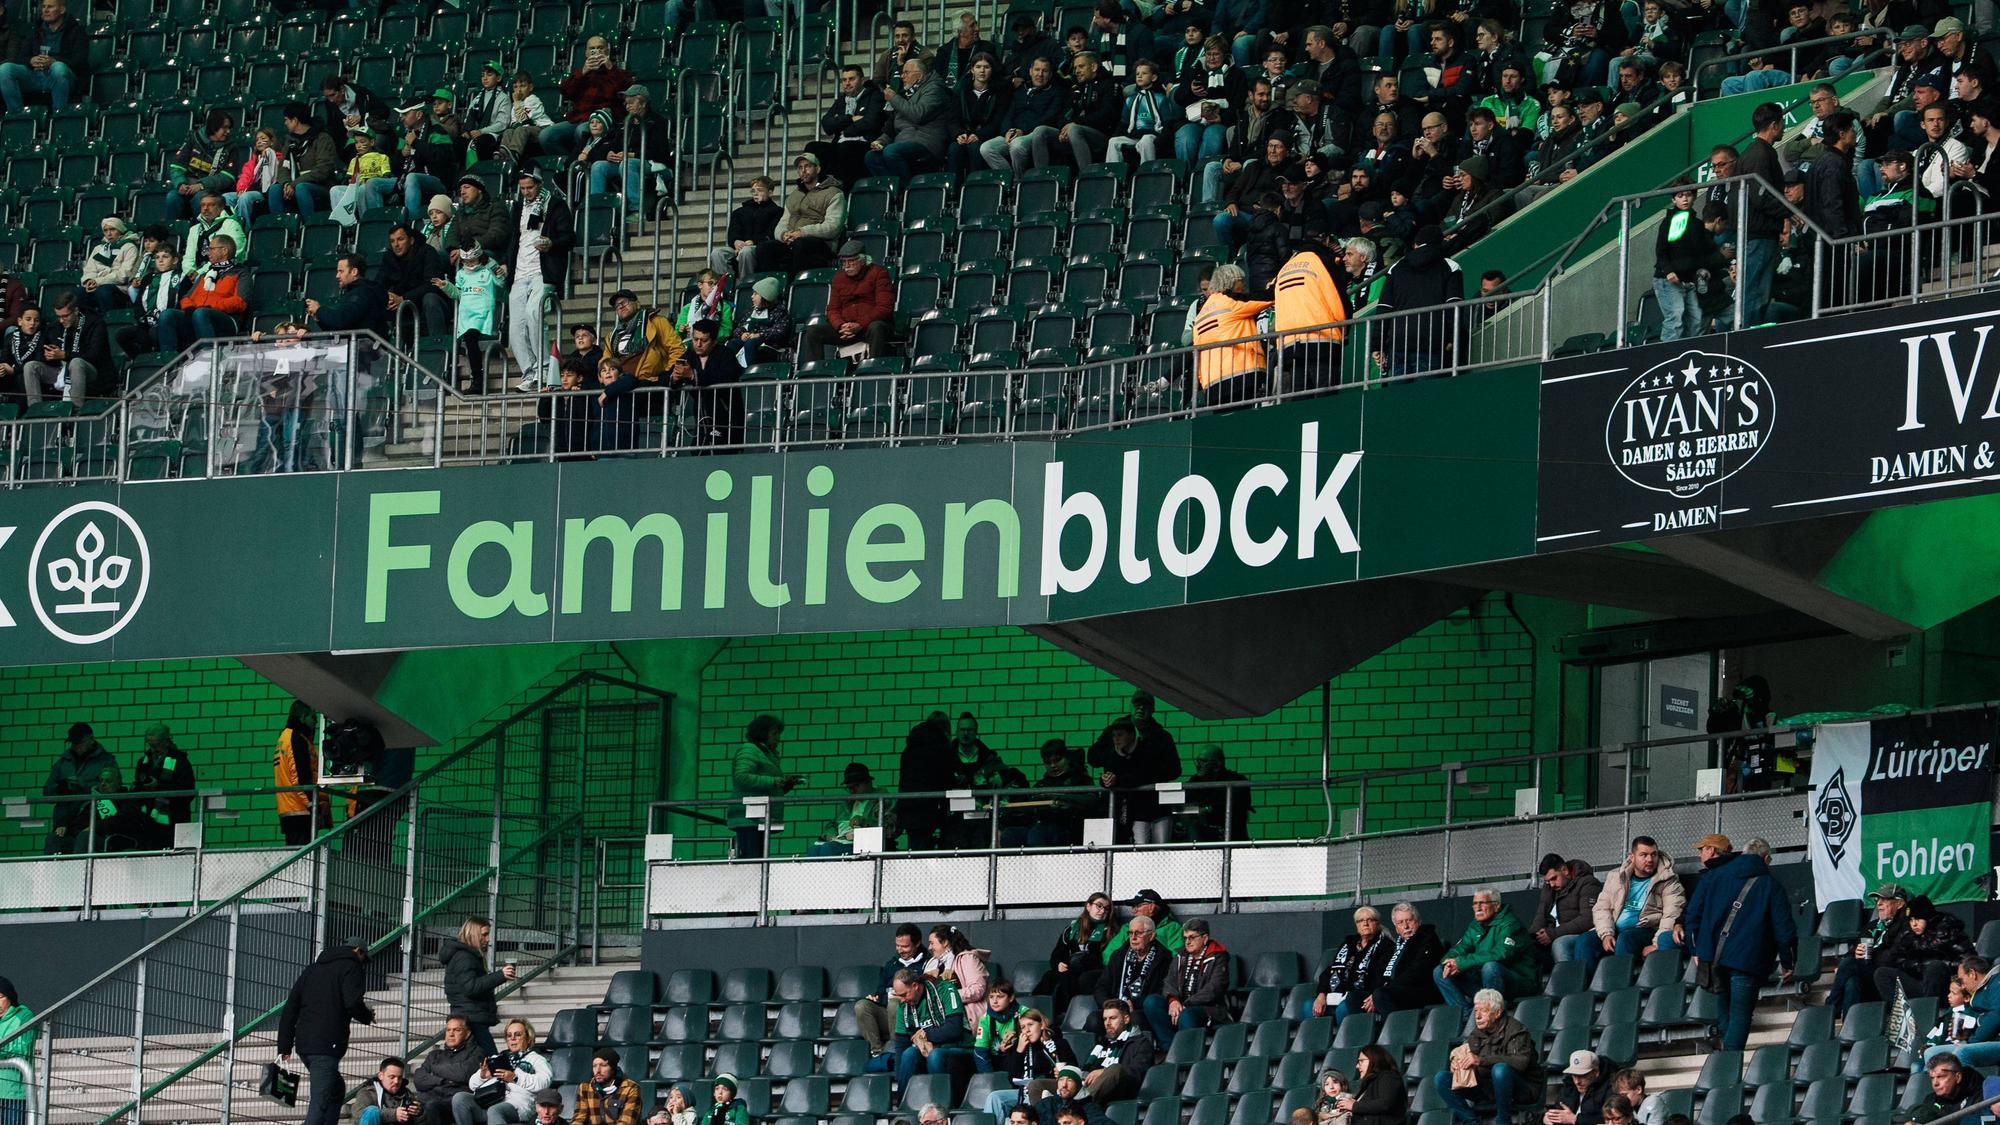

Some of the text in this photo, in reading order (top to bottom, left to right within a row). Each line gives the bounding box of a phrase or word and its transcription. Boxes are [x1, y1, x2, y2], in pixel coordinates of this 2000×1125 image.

[1897, 325, 2000, 431] IV
[1623, 381, 1759, 443] IVAN'S
[1623, 430, 1759, 466] DAMEN & HERREN
[1870, 441, 1995, 485] DAMEN &
[1666, 458, 1717, 482] SALON
[1653, 505, 1718, 531] DAMEN
[1870, 740, 1990, 782] Lürriper
[1877, 837, 1975, 880] Fohlen
